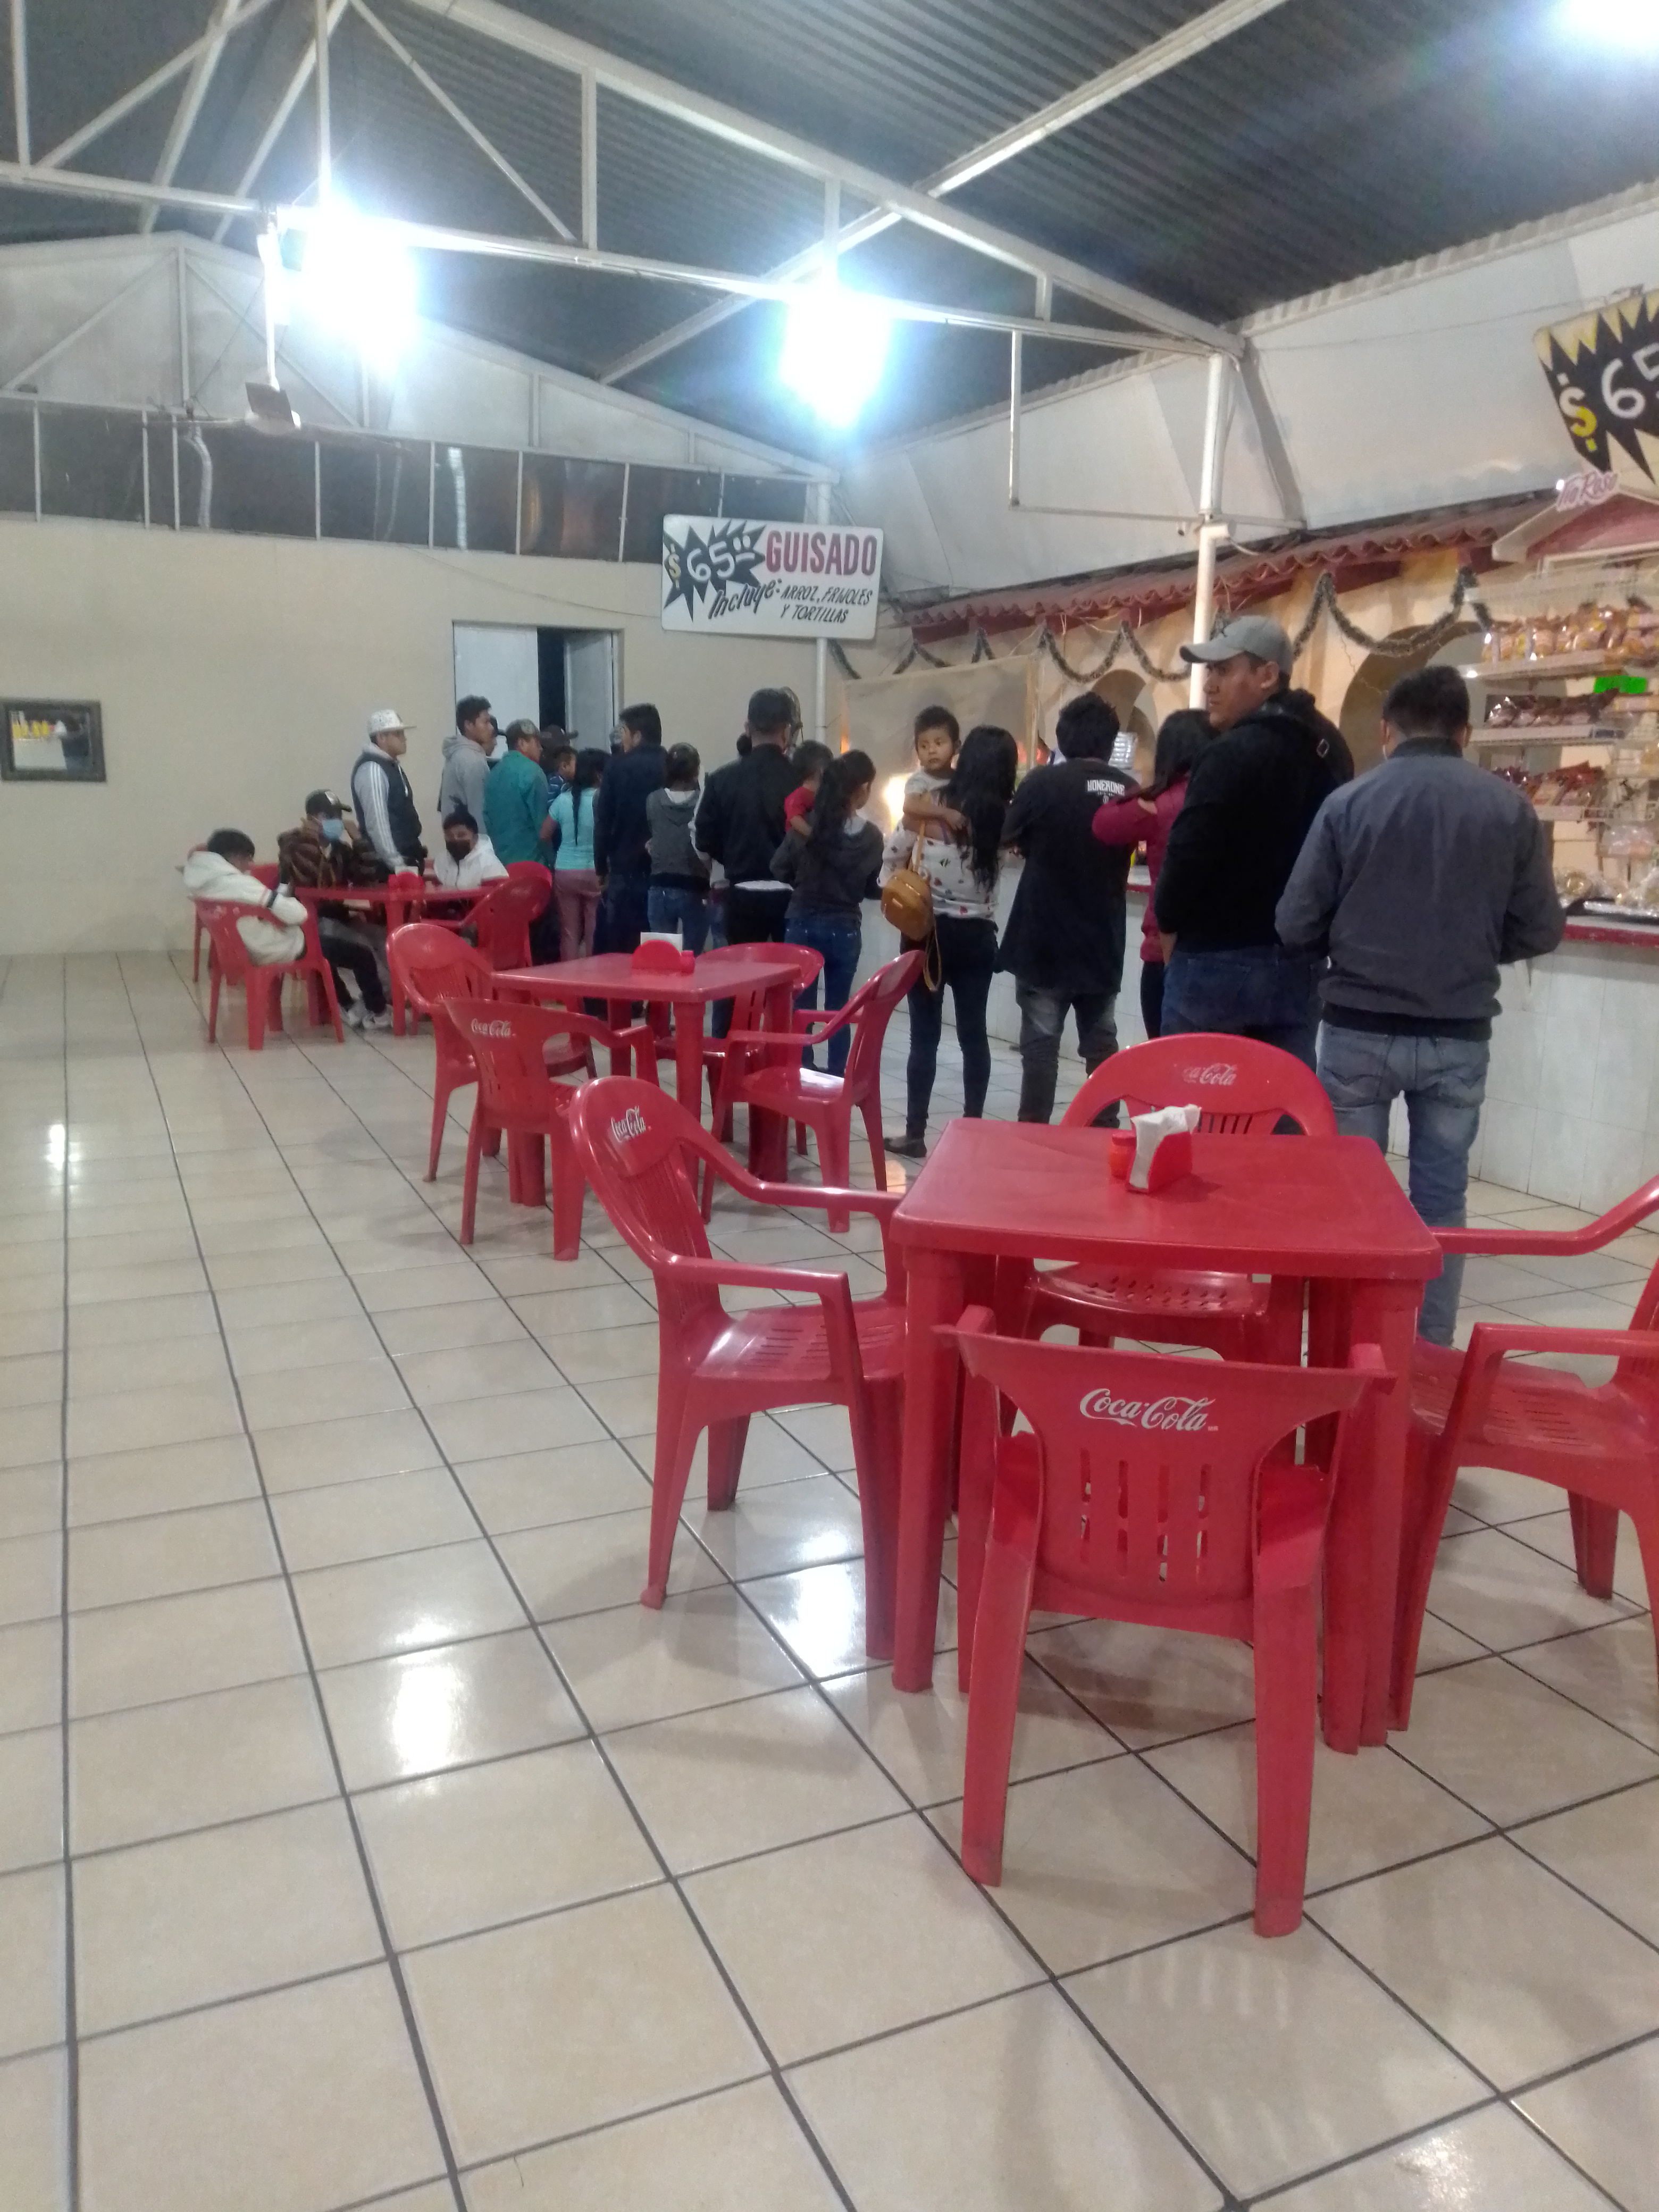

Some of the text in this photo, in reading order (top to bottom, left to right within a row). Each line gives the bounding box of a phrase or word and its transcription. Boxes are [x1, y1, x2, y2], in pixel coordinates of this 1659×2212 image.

[766, 530, 877, 576] GUISADO
[708, 578, 873, 619] Incluye: ARROZ, FRIJOLES
[780, 604, 849, 624] Y TORTILLAS
[1079, 1388, 1217, 1431] Coca-Cola
